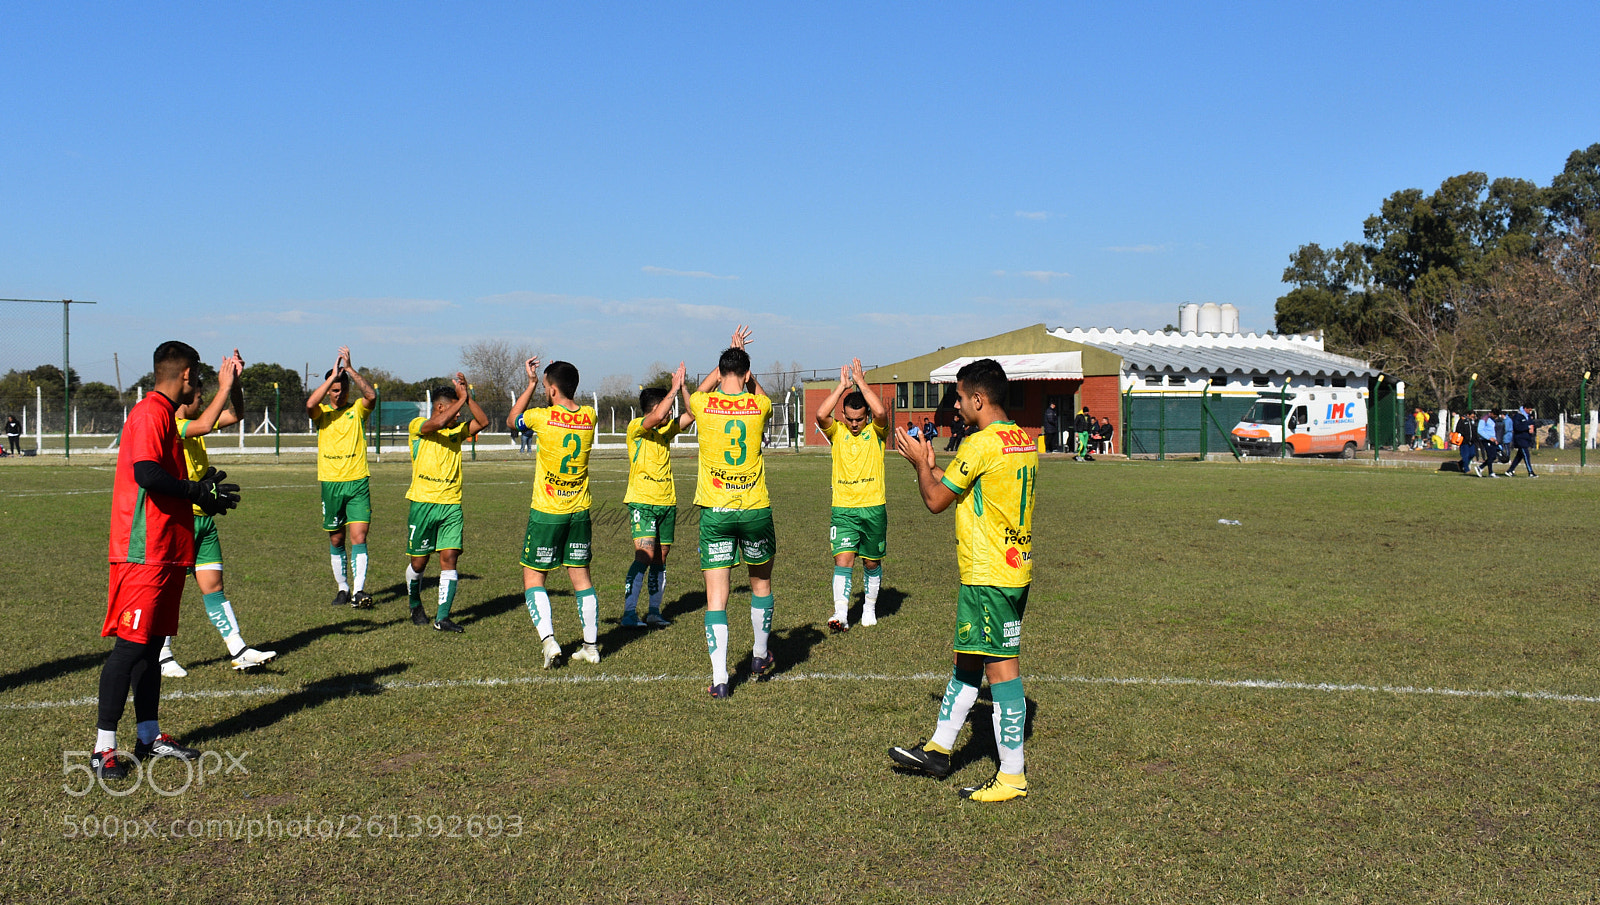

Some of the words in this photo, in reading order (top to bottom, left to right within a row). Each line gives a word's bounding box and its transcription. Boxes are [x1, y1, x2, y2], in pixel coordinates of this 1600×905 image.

[707, 396, 759, 410] ROCA
[1326, 402, 1355, 420] IMC
[551, 410, 592, 425] ROCA
[560, 433, 582, 474] 2
[724, 419, 747, 466] 3
[409, 524, 417, 540] 7
[132, 608, 142, 630] 1
[209, 609, 231, 633] LYON
[1004, 707, 1023, 743] LYON
